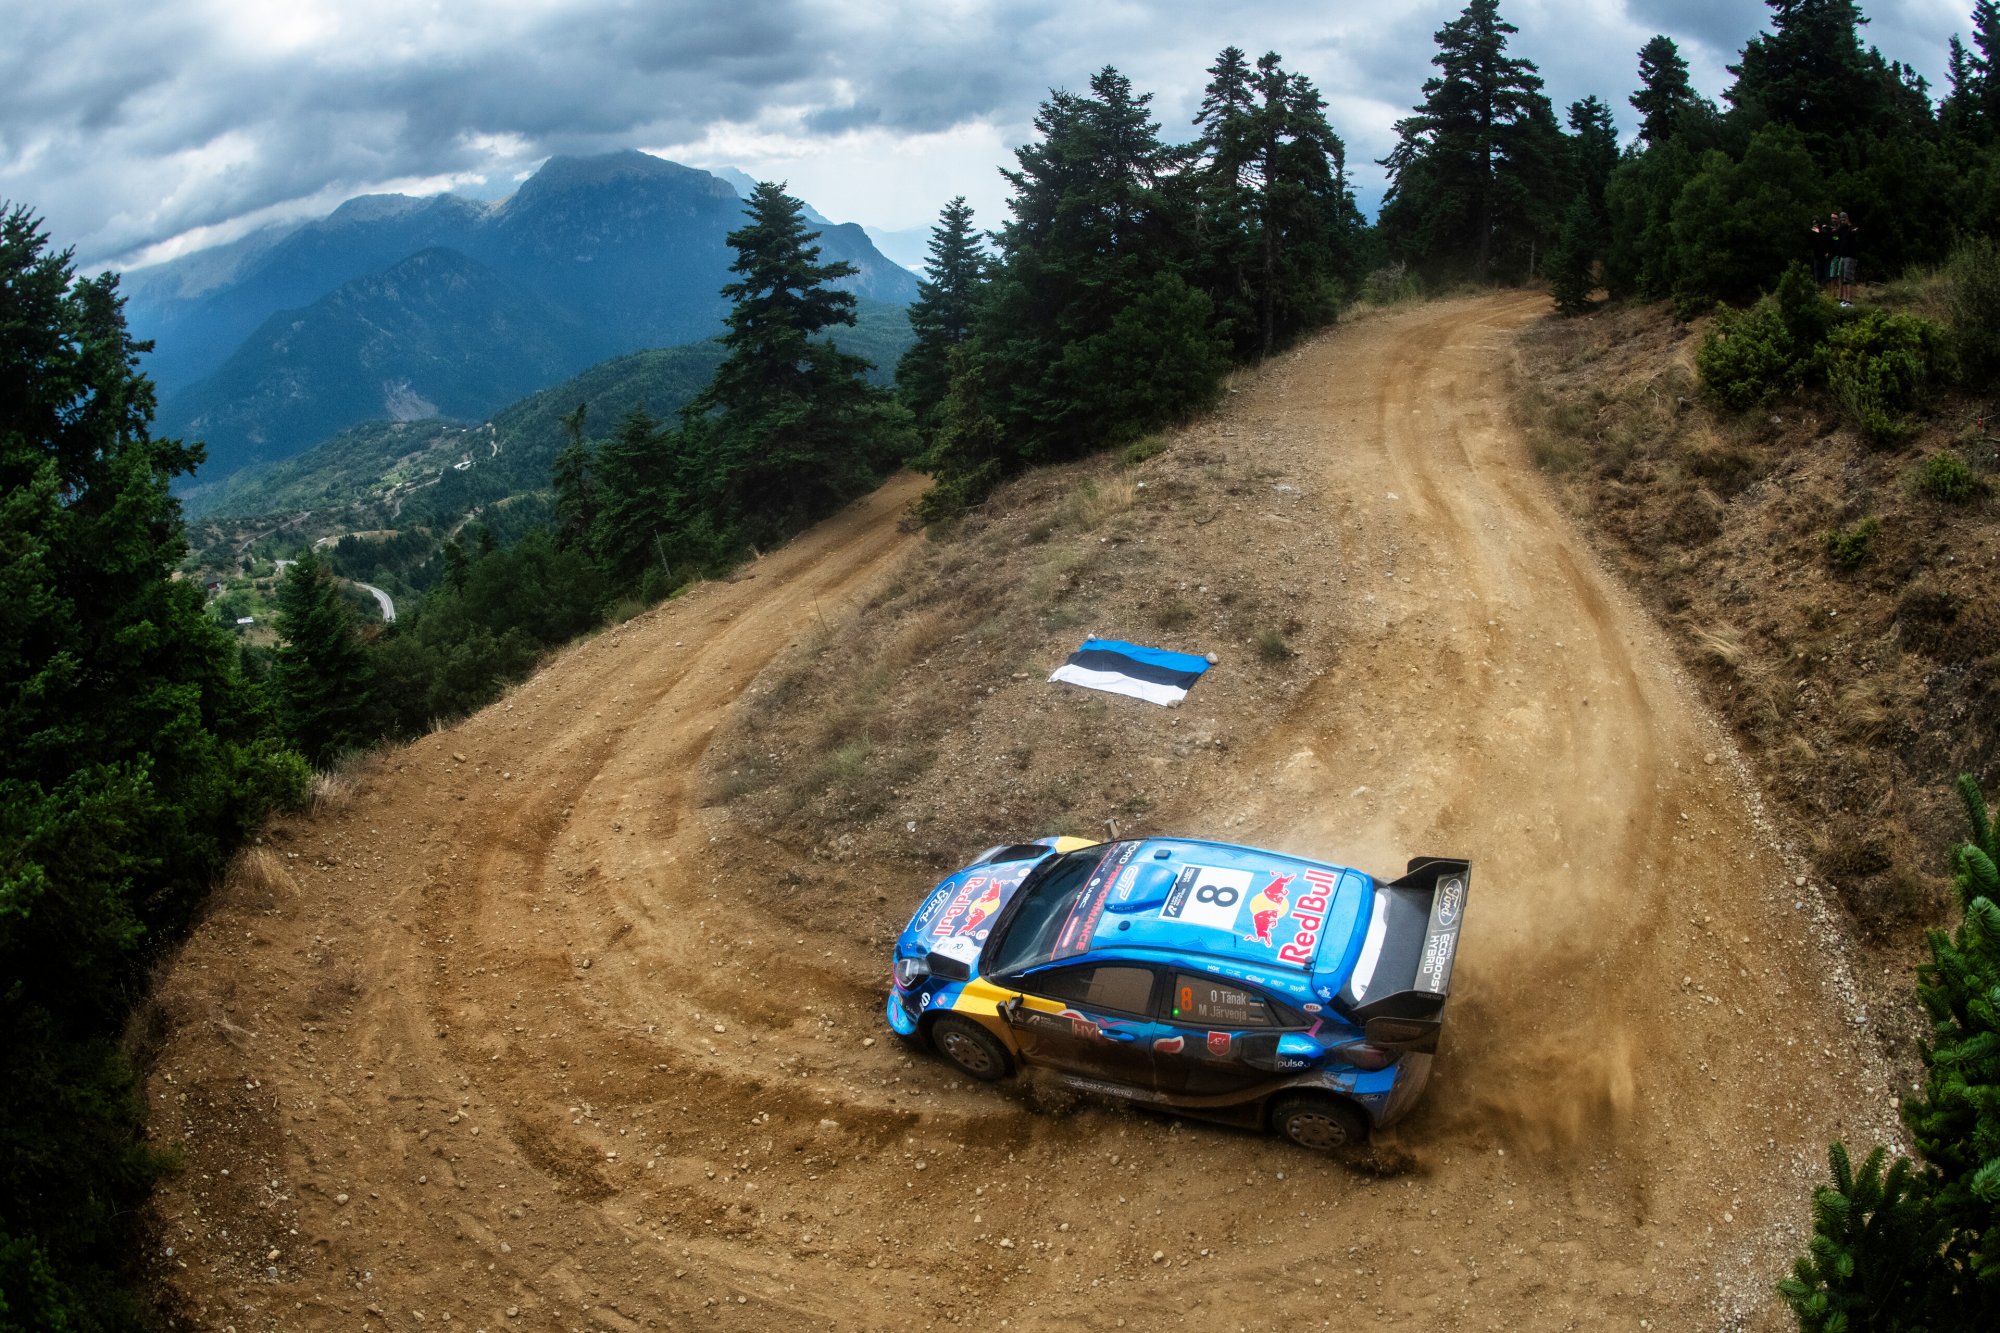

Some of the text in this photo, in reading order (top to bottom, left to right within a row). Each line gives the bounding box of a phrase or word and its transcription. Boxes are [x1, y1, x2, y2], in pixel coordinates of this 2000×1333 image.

[1119, 841, 1141, 864] FORD
[920, 889, 949, 922] Ford
[1196, 884, 1239, 907] 8
[1297, 869, 1336, 913] Bull
[1441, 887, 1460, 917] Ford
[1076, 865, 1124, 951] PERFORMANCE
[1277, 911, 1322, 966] Red
[1423, 935, 1440, 974] HYBRID
[1430, 933, 1450, 993] ECOBOOST
[1181, 987, 1193, 1011] 8
[1198, 1004, 1207, 1016] M
[1220, 990, 1247, 1006] Tänak
[1074, 1023, 1095, 1038] HY
